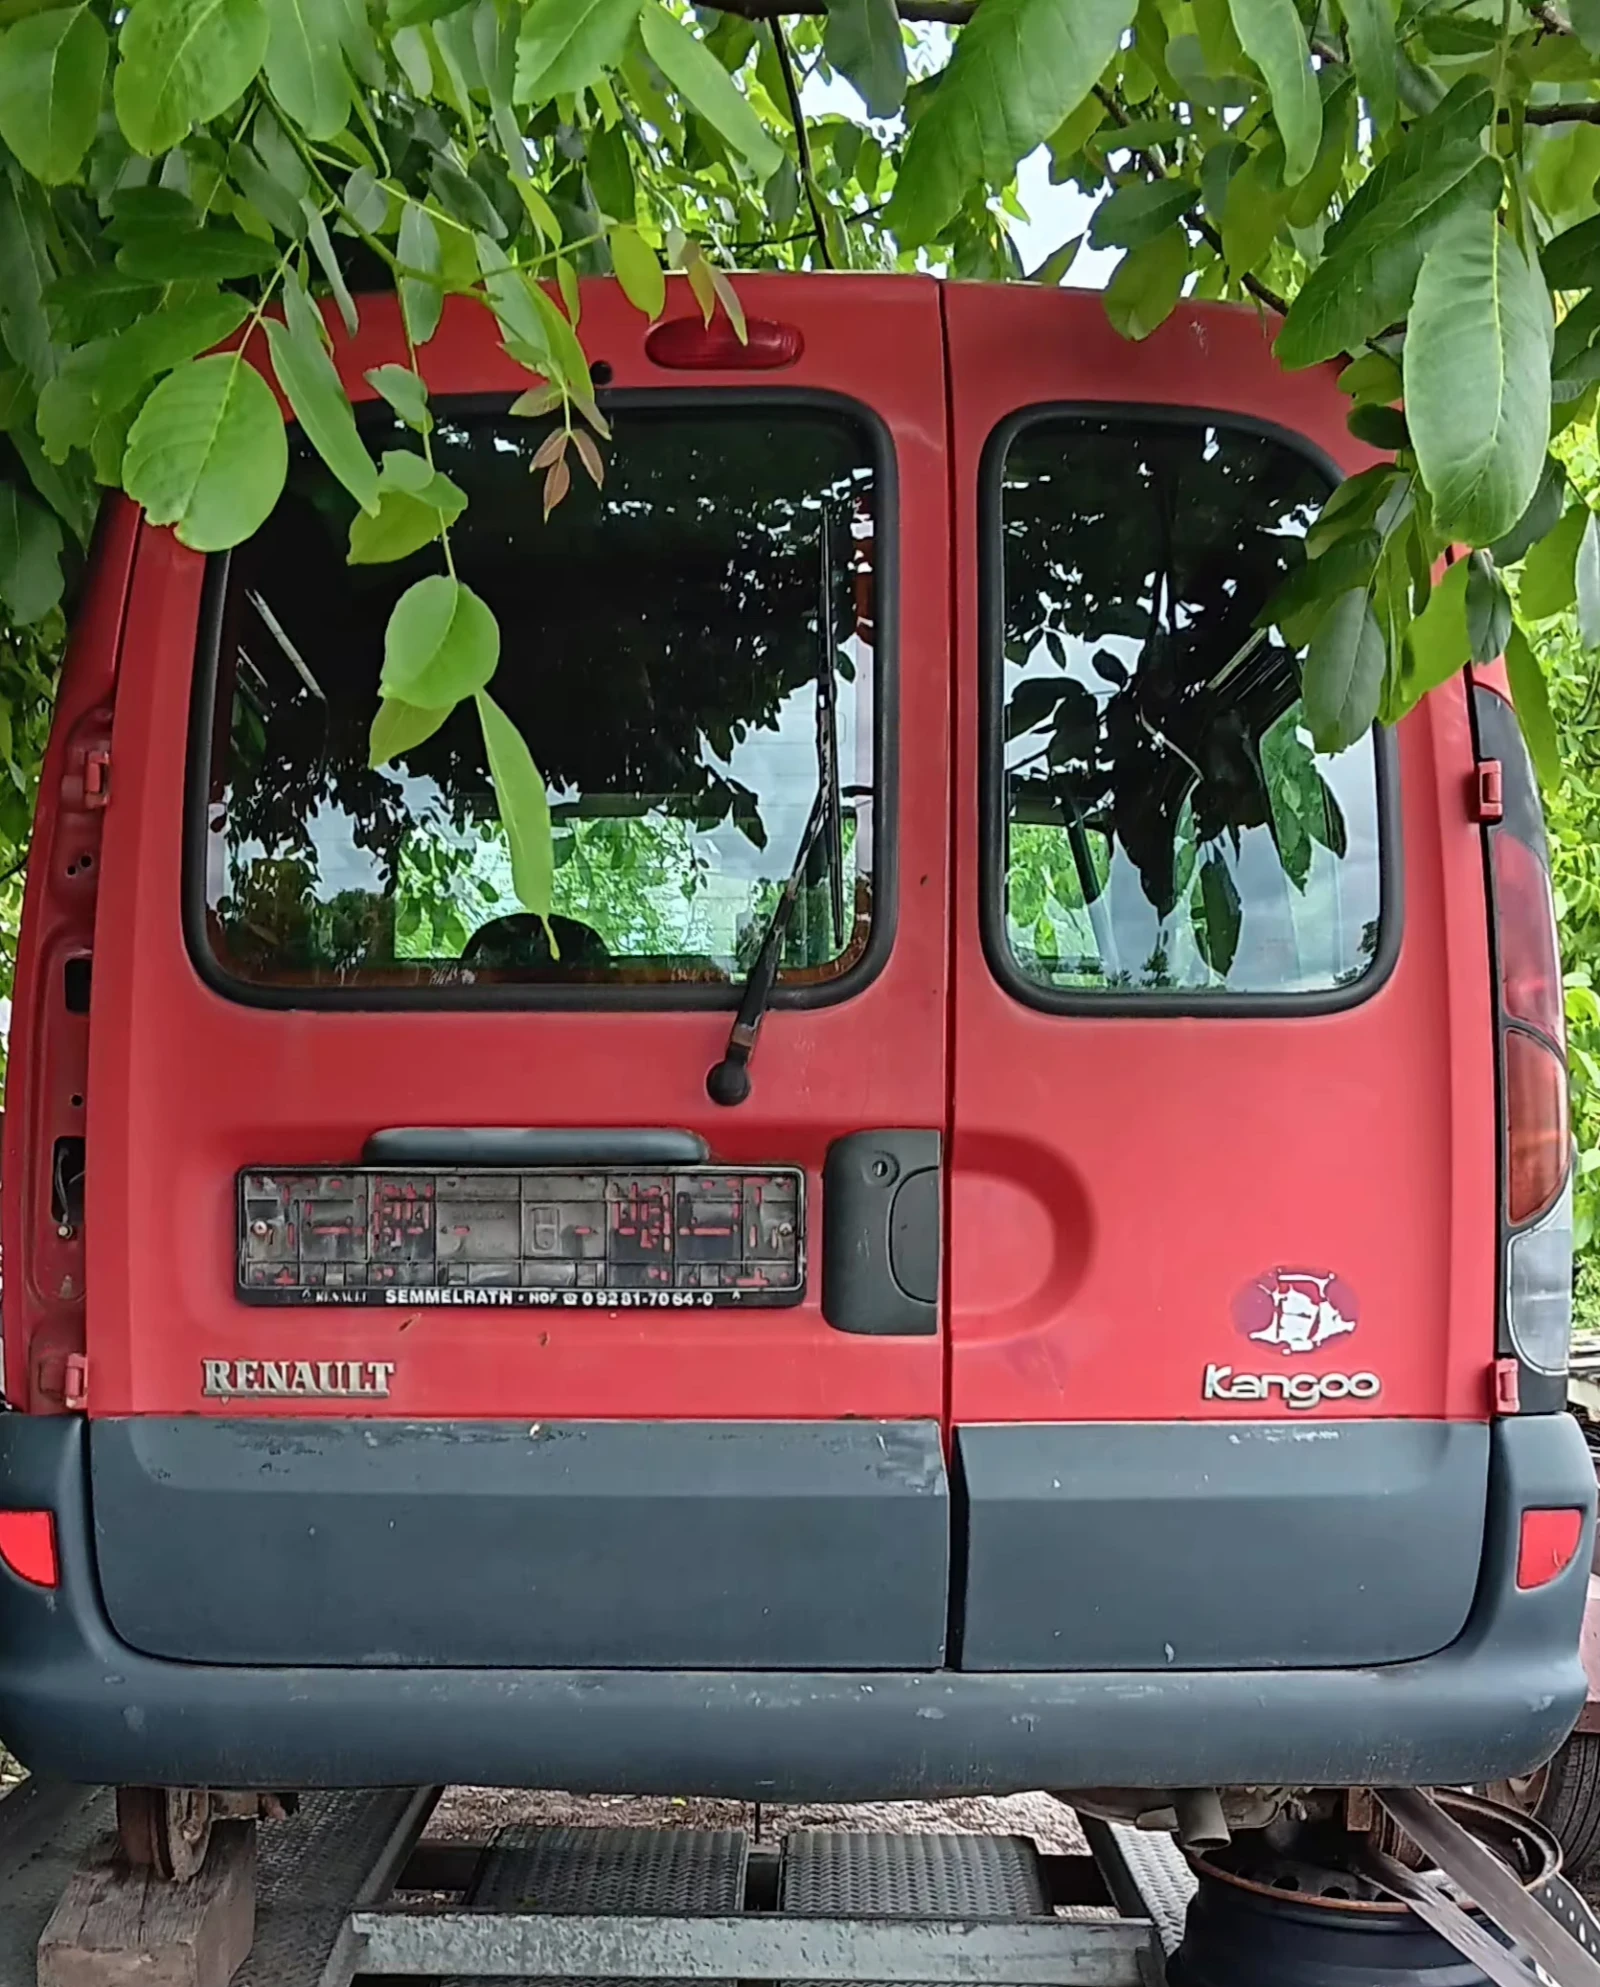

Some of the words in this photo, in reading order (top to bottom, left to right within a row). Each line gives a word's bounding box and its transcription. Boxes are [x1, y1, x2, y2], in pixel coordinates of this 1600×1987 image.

[385, 1290, 513, 1305] SEMMELRATH
[529, 1292, 558, 1304] HOF
[202, 1359, 395, 1397] RENAULT
[1203, 1364, 1381, 1409] Kangoo
